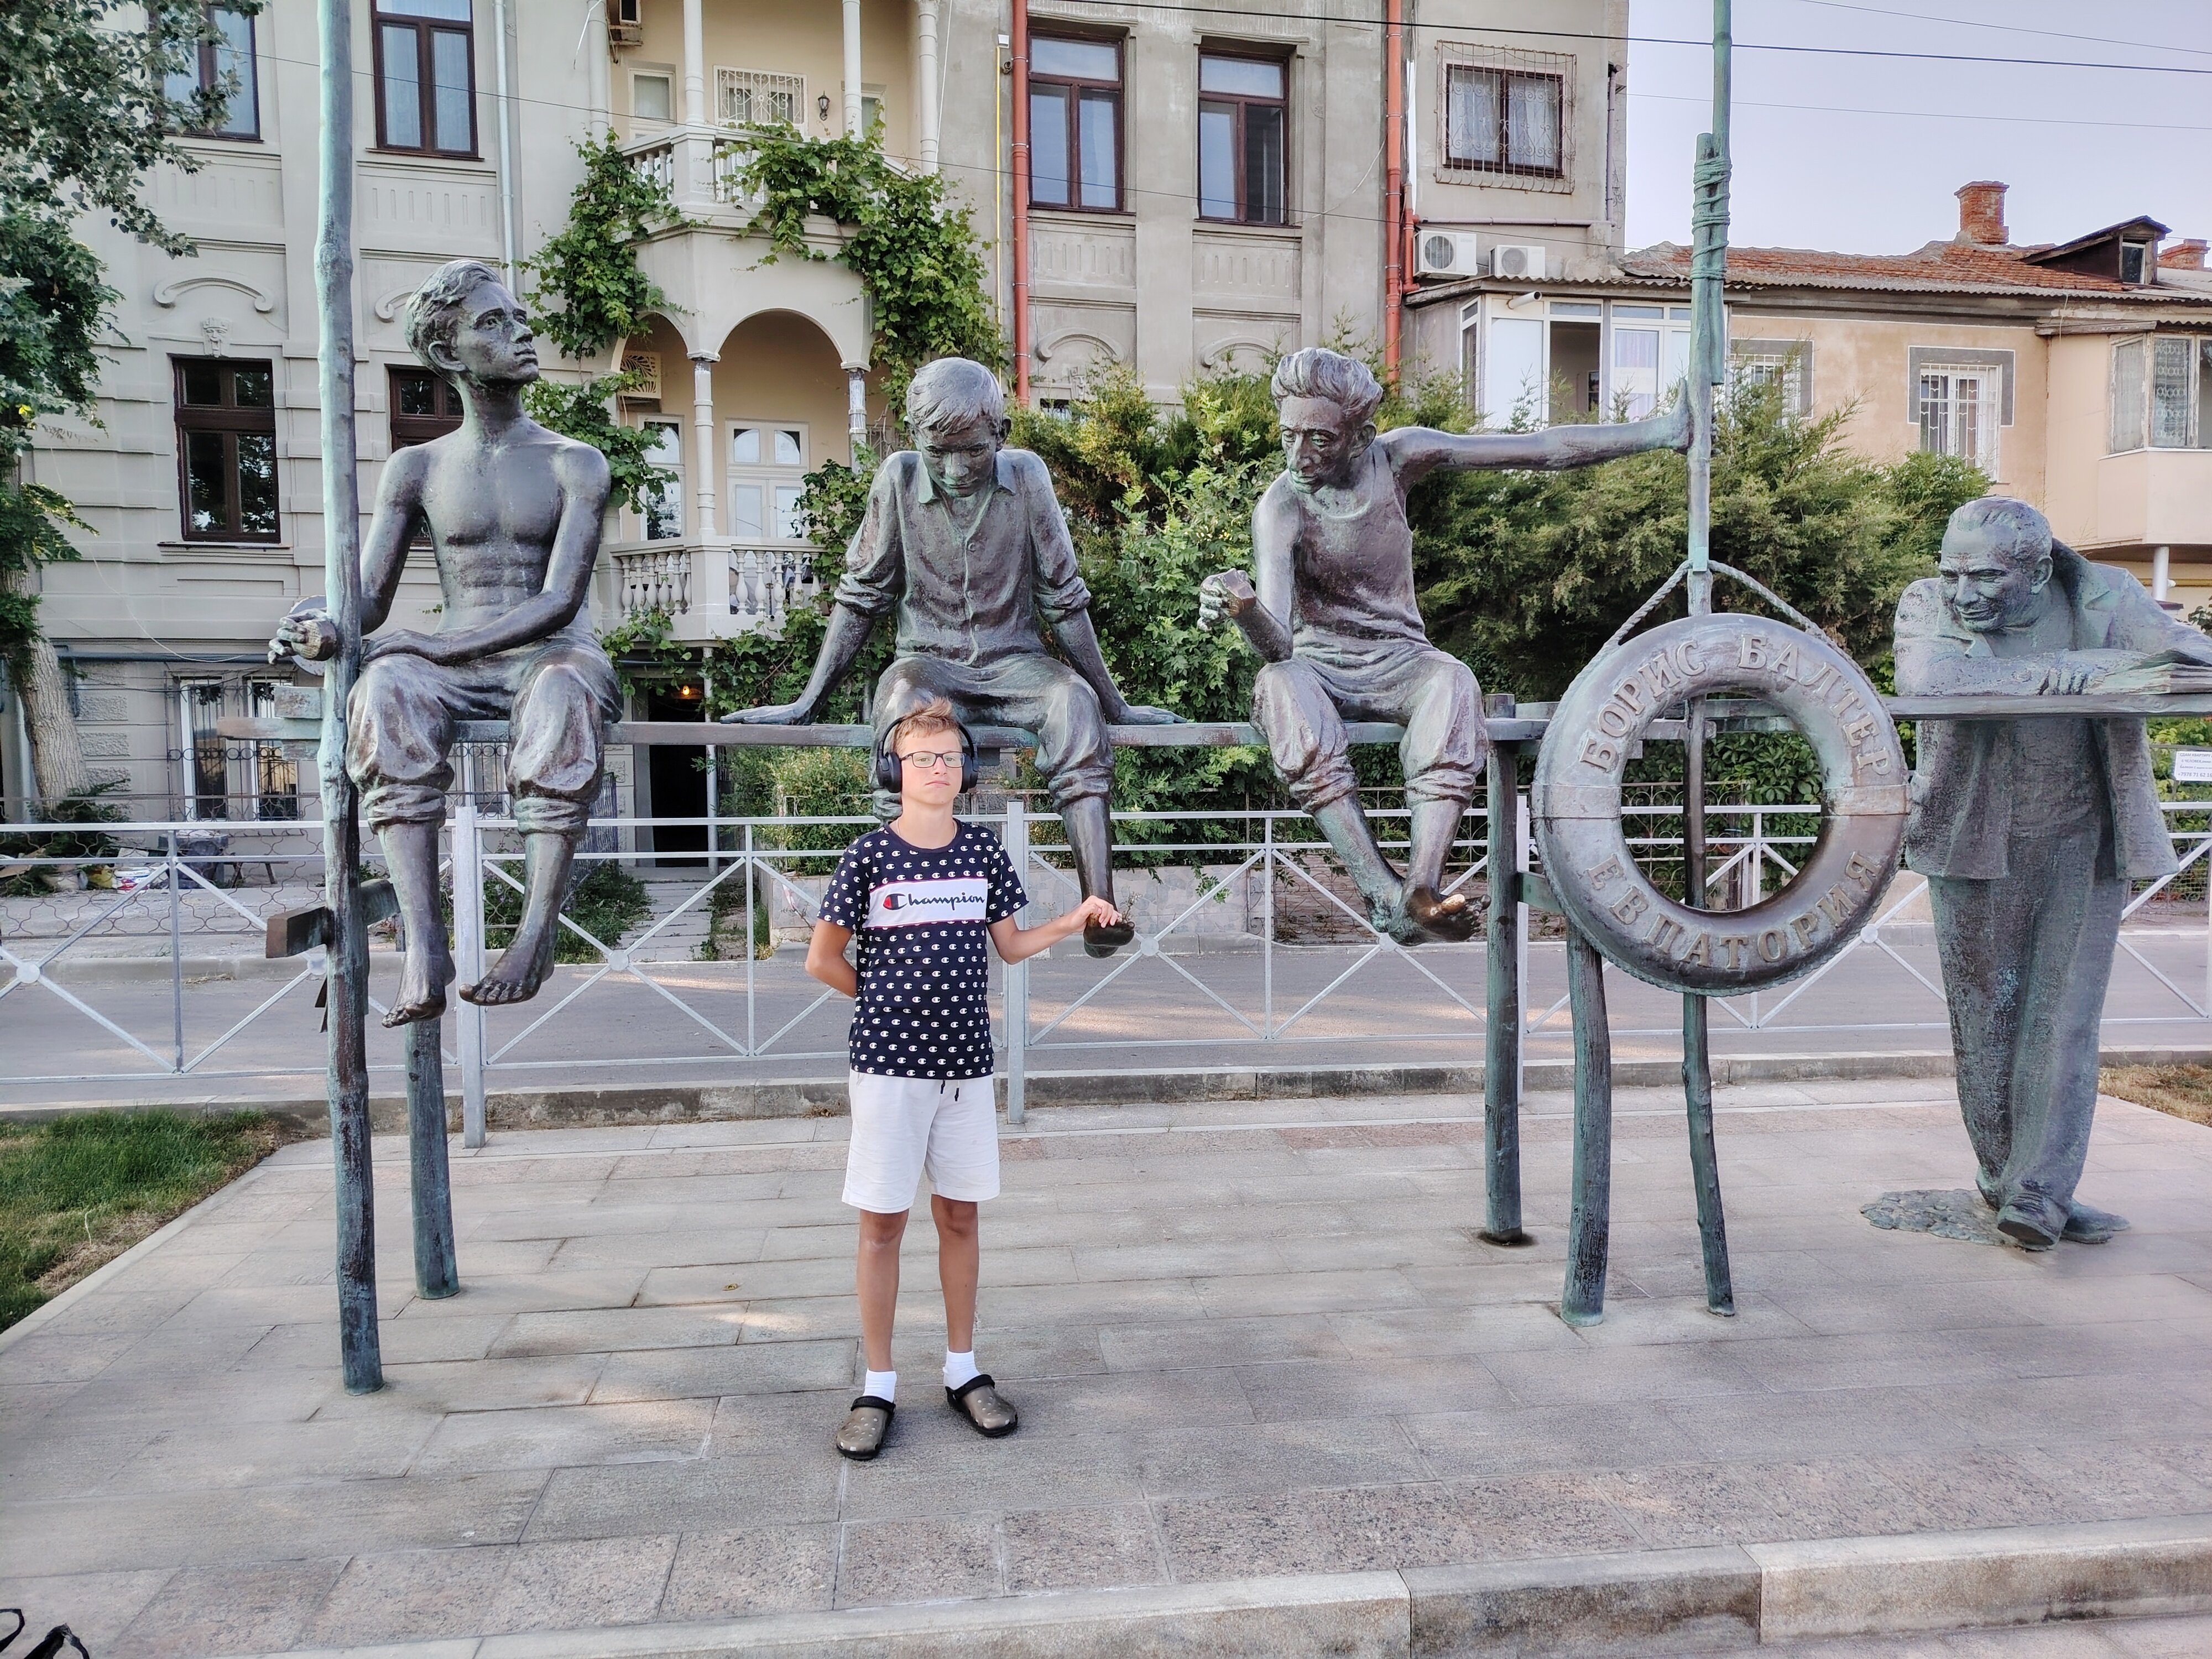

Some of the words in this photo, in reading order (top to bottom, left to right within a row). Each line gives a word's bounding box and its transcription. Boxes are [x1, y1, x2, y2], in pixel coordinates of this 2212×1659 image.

[1580, 640, 1707, 773] БОРИС
[1738, 634, 1892, 775] БАЛТЕР
[883, 892, 985, 911] Champion
[1585, 852, 1880, 969] ЕВПАТОРИЯ
